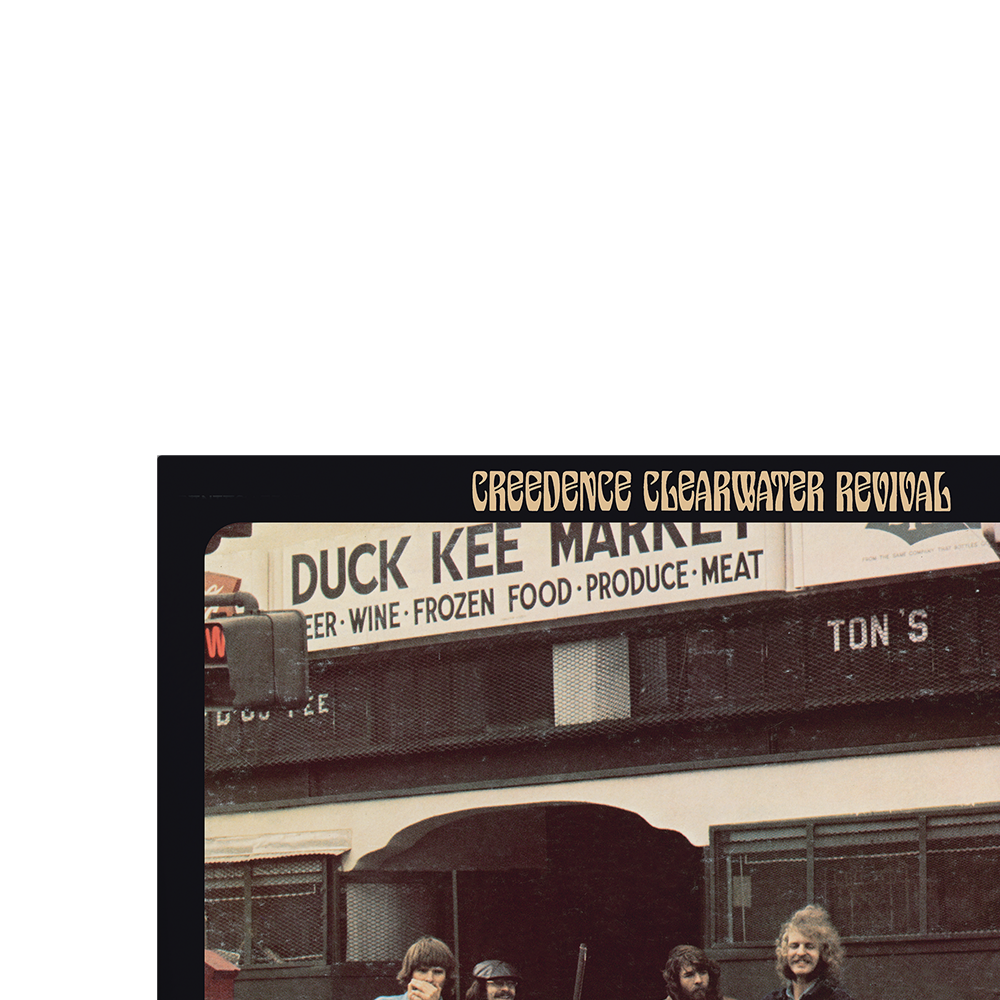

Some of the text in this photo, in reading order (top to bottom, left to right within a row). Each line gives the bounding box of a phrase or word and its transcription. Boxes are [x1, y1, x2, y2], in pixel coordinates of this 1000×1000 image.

[471, 470, 951, 512] CREEDENCE CLEARWATER REVIVAL
[292, 535, 412, 606] DUCK
[432, 522, 524, 585] KEE
[861, 555, 877, 563] FROM
[892, 551, 906, 559] SAME
[908, 547, 935, 556] COMPANY
[937, 544, 951, 552] THAT
[953, 541, 978, 551] BOTTLES
[305, 549, 764, 640] EER WINE FROZEN FOOD PRODUCE MEAT
